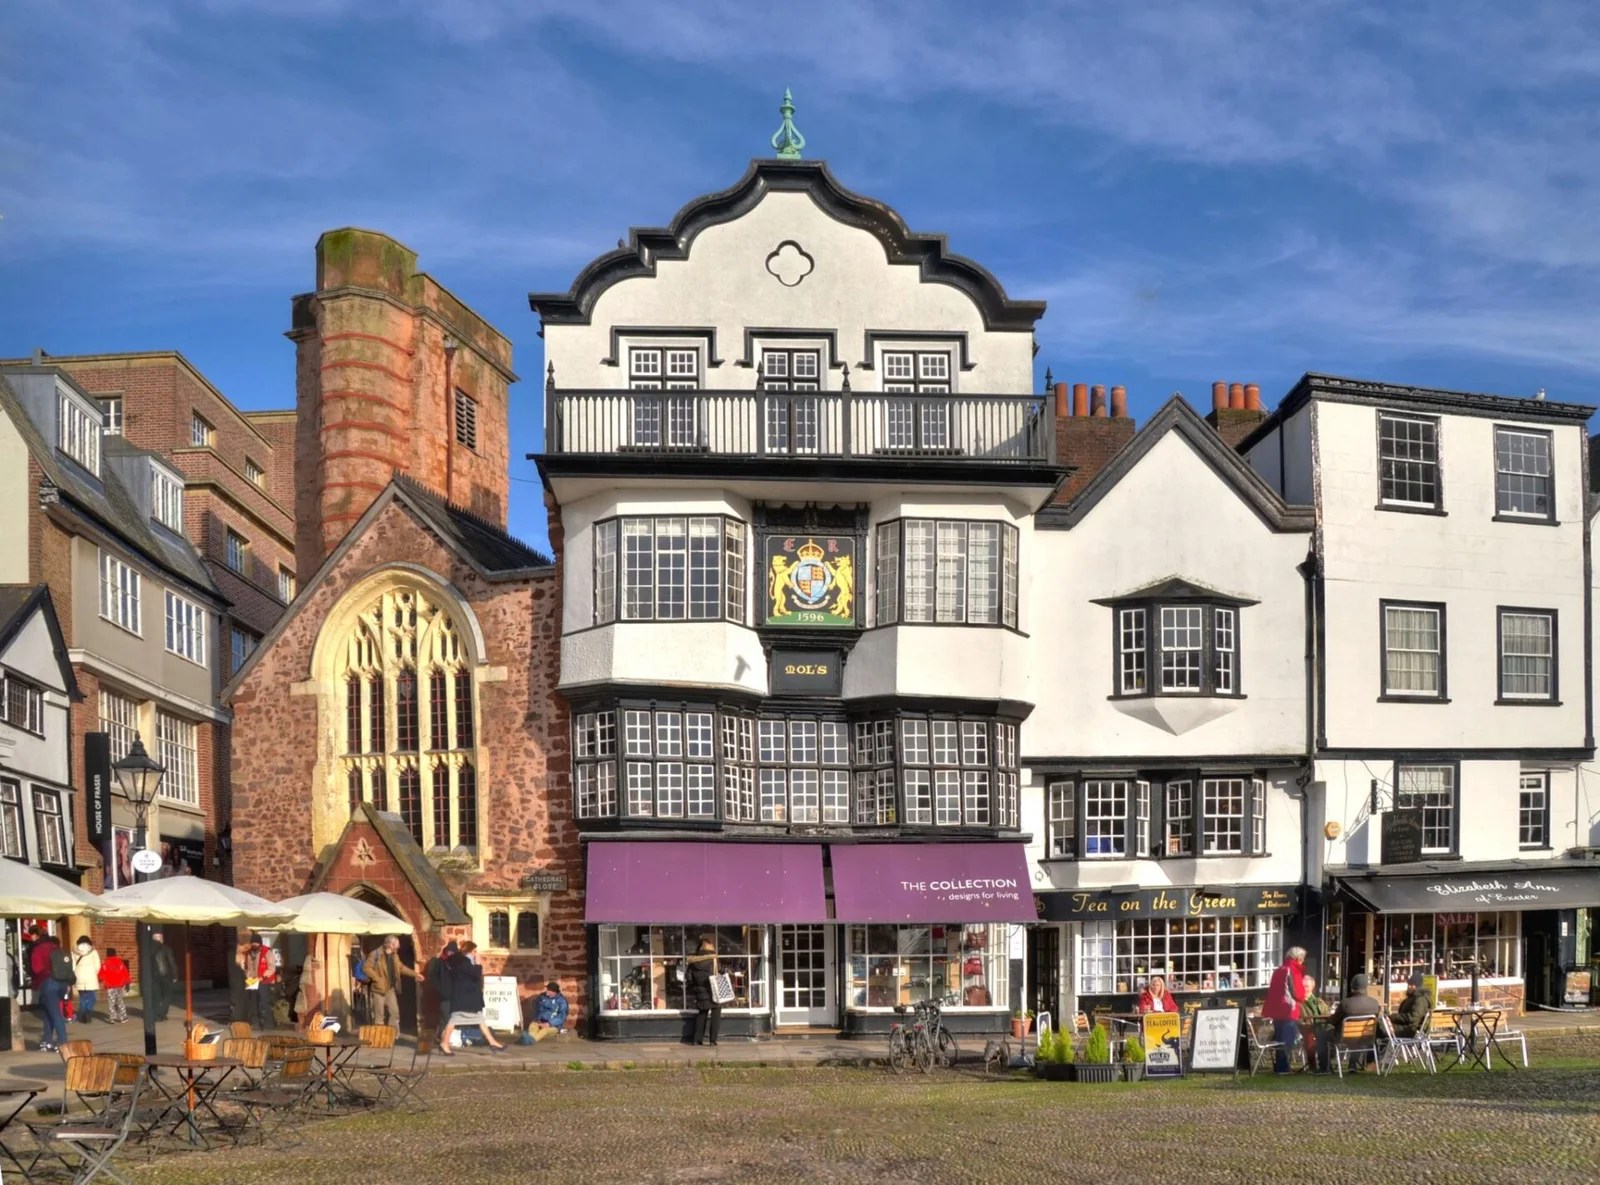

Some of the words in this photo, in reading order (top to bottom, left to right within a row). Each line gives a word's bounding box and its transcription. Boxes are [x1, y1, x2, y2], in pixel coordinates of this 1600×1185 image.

[797, 612, 824, 622] 1596
[785, 664, 828, 675] MOL'S
[95, 799, 102, 810] OF
[525, 875, 563, 883] CATHEDRAL
[900, 881, 927, 891] THE
[929, 879, 1017, 891] COLLECTION
[1427, 881, 1508, 896] Elizabeth
[1514, 881, 1560, 891] Ann
[949, 892, 980, 901] designs
[981, 891, 994, 899] for
[1475, 895, 1490, 903] of
[1488, 893, 1539, 902] Exeter
[1072, 893, 1108, 913] Tea
[1121, 901, 1141, 911] on
[1153, 891, 1178, 910] the
[1190, 889, 1237, 916] Green
[1439, 912, 1475, 924] SALE
